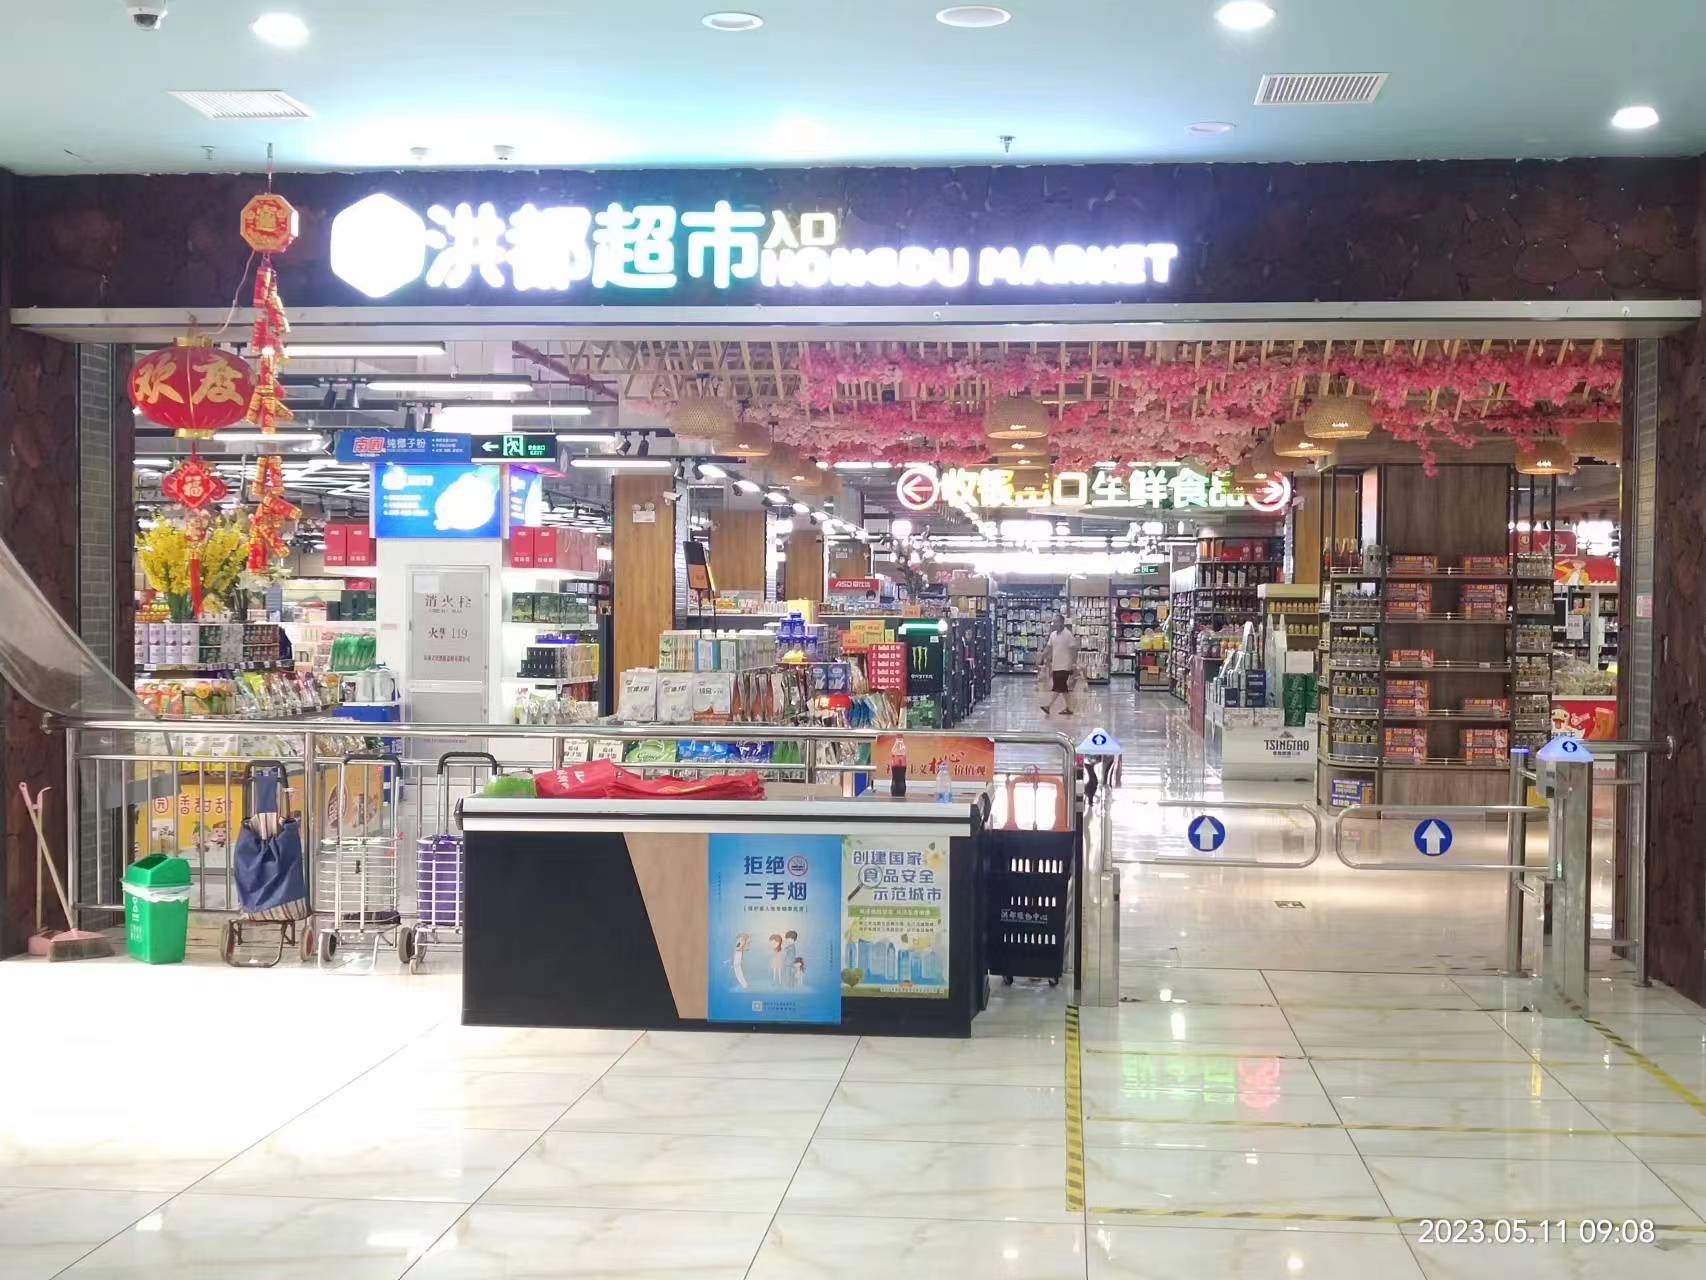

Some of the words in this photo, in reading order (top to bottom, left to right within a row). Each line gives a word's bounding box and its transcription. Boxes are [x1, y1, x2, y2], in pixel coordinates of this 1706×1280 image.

[764, 210, 837, 249] 入口
[424, 200, 766, 290] 洪都超市
[761, 246, 970, 287] HONGDU
[979, 243, 1178, 286] MARKET
[1263, 739, 1309, 751] TSINGTAO
[743, 855, 785, 876] 拒绝
[852, 850, 922, 866] 创建国家
[863, 868, 935, 885] 食品安全
[743, 881, 807, 901] 二手烟
[873, 887, 942, 902] 示范城市
